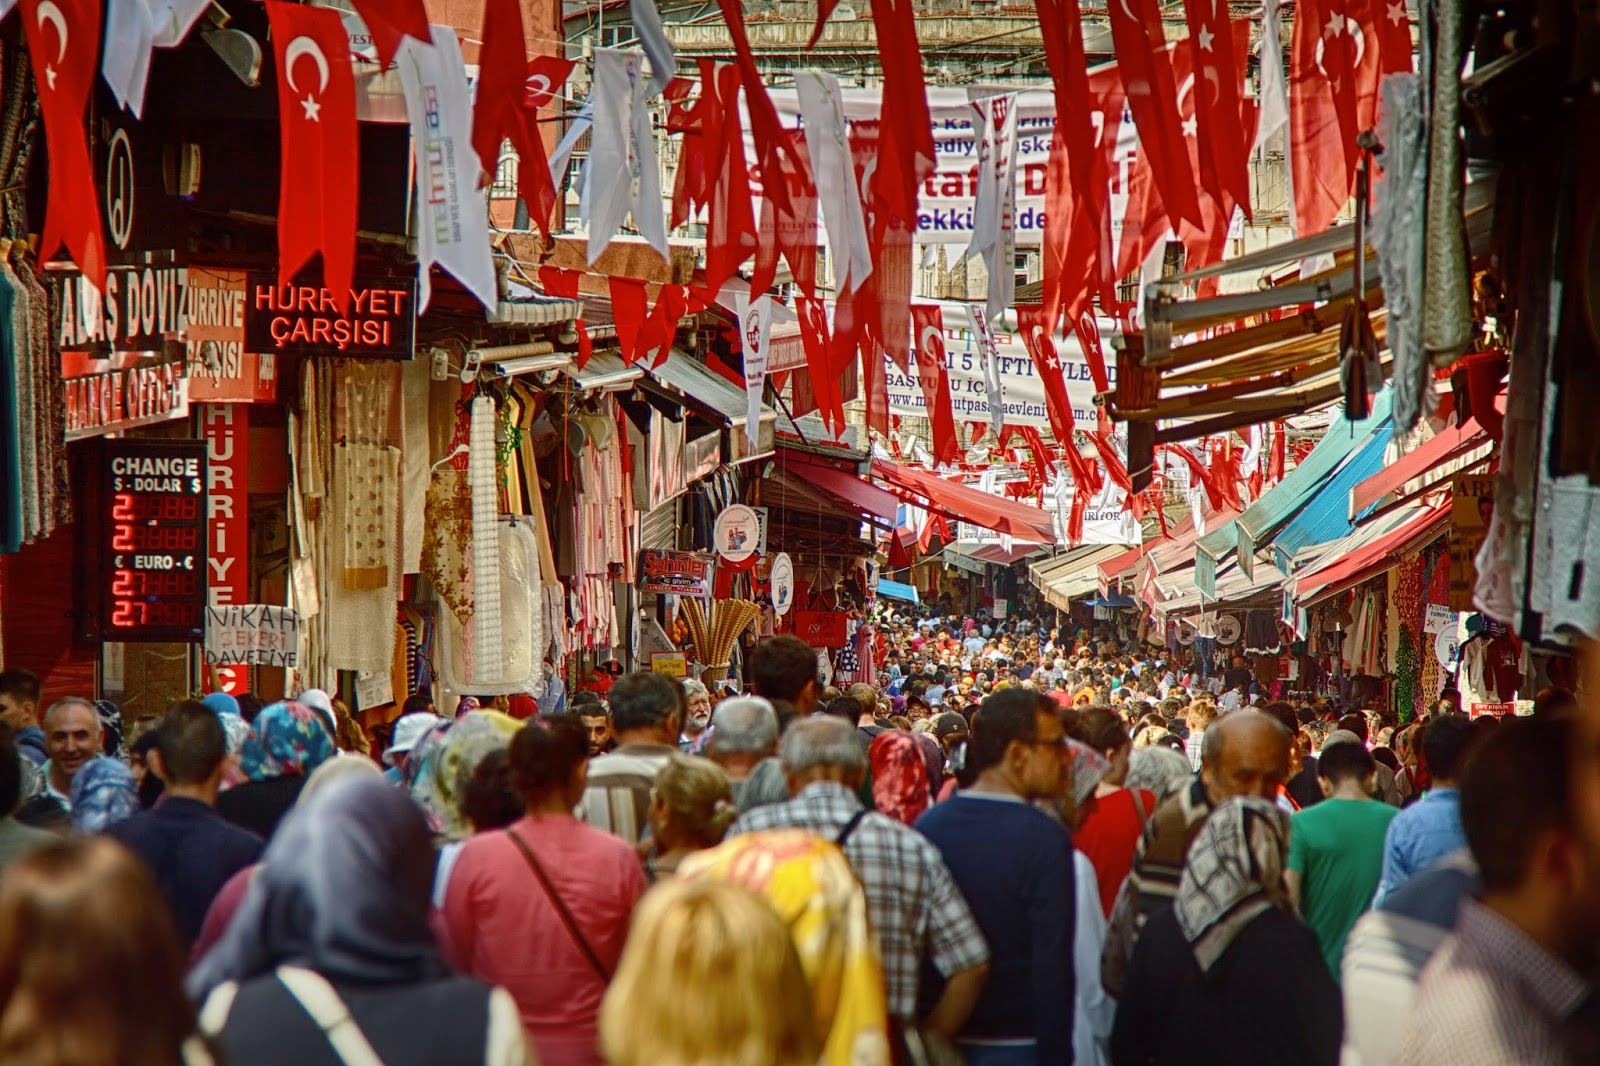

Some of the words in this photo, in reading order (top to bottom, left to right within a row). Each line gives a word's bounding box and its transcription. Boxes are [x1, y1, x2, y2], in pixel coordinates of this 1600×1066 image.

[256, 281, 408, 317] HÜRRYET
[270, 317, 391, 350] ÇARŞISI
[112, 457, 198, 476] CHANGE
[134, 478, 181, 492] DOLAR
[135, 555, 173, 569] EURO
